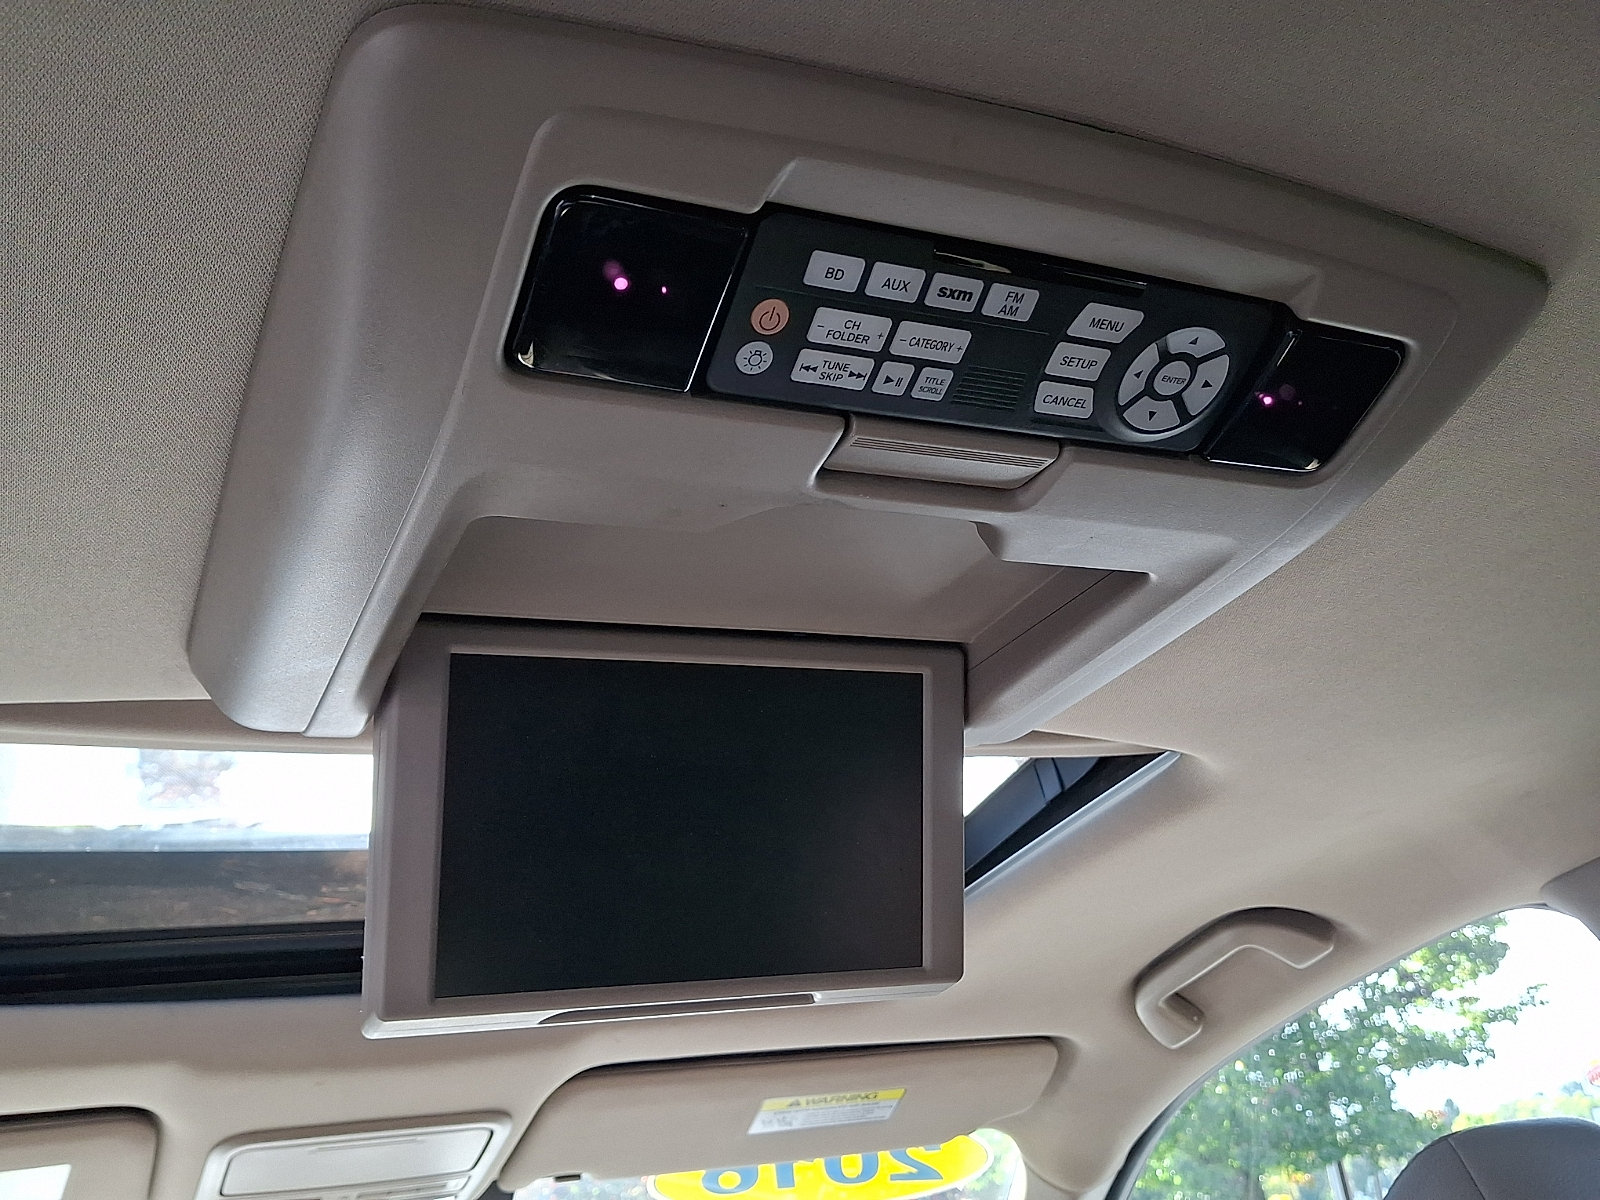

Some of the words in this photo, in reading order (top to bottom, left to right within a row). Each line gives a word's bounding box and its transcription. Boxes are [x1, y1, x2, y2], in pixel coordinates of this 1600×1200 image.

[825, 267, 845, 280] BD
[881, 277, 911, 292] AUX
[937, 287, 973, 301] sxm
[1005, 291, 1025, 304] FM
[998, 304, 1019, 317] AM
[844, 319, 861, 331] CH
[1089, 318, 1124, 332] MENU
[825, 330, 870, 344] FOLDER
[909, 336, 955, 352] CATEGORY
[822, 360, 851, 372] TUNE
[1060, 356, 1098, 371] SETUP
[818, 371, 843, 382] SKIP
[924, 376, 945, 386] TITLE
[1161, 375, 1187, 385] ENTER
[918, 385, 942, 395] SCROLL
[1042, 395, 1087, 409] CANCEL
[805, 1092, 878, 1106] WARNING
